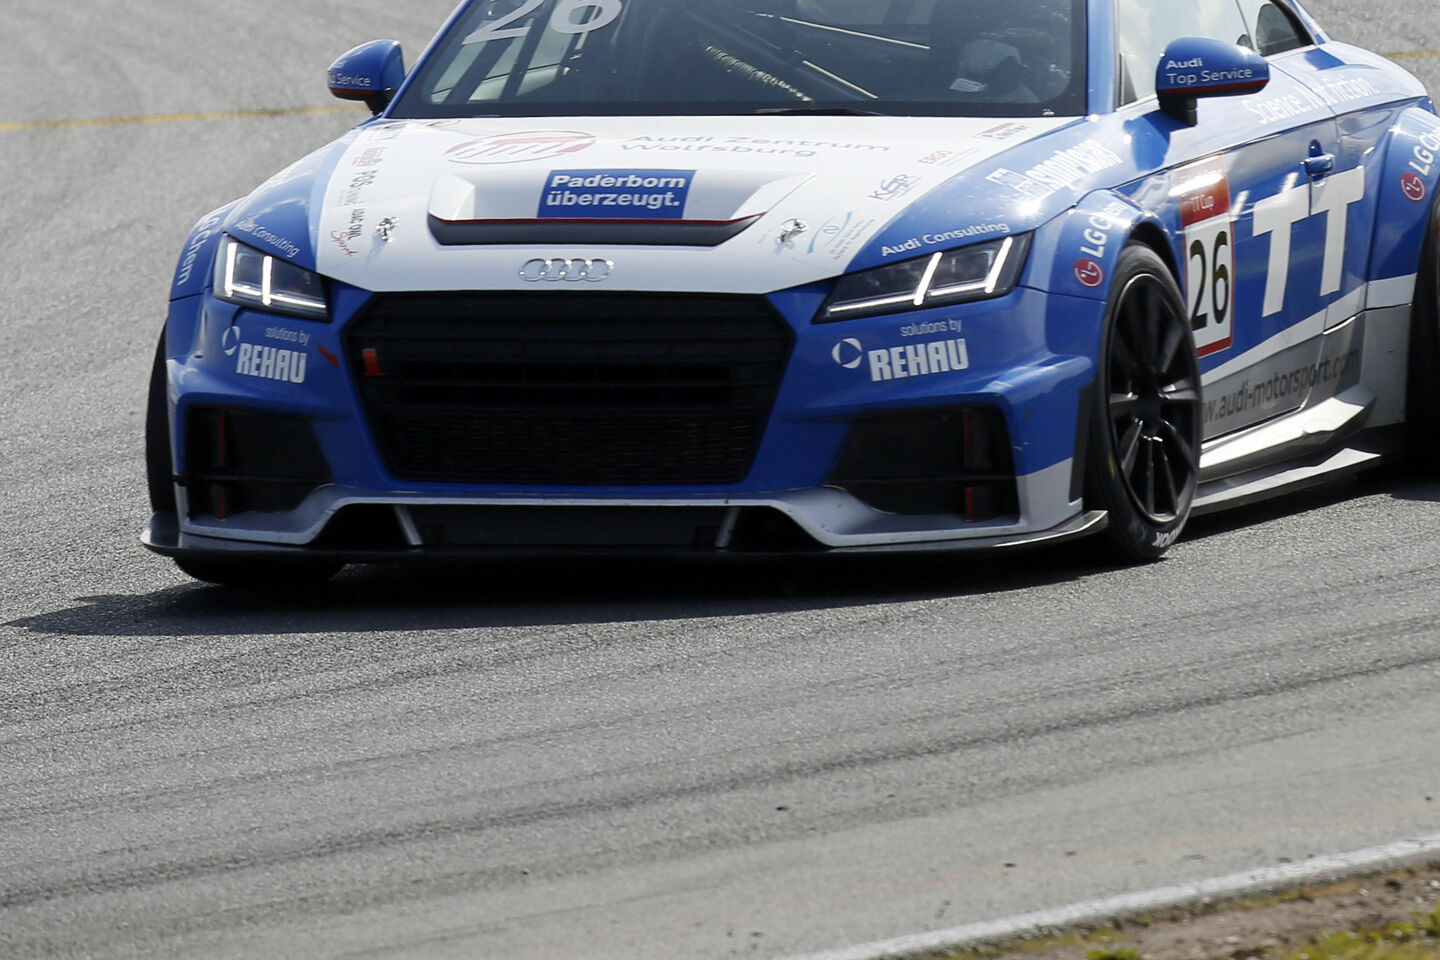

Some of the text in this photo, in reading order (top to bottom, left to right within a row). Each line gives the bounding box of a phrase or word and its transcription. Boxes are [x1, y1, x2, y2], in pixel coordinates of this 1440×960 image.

[1166, 57, 1203, 69] Audi
[1167, 68, 1253, 85] Top Service
[621, 143, 817, 158] Wolfsburg
[551, 173, 685, 189] Paderborn
[545, 189, 682, 209] überzeugt.
[252, 227, 300, 258] Consulting
[882, 238, 920, 257] Audi
[922, 222, 1011, 245] Consulting
[1253, 165, 1364, 318] TT
[1190, 231, 1229, 330] 26
[265, 326, 311, 345] solutions by
[900, 317, 962, 337] solutions by
[236, 343, 307, 384] REHAU
[868, 338, 969, 382] REHAU
